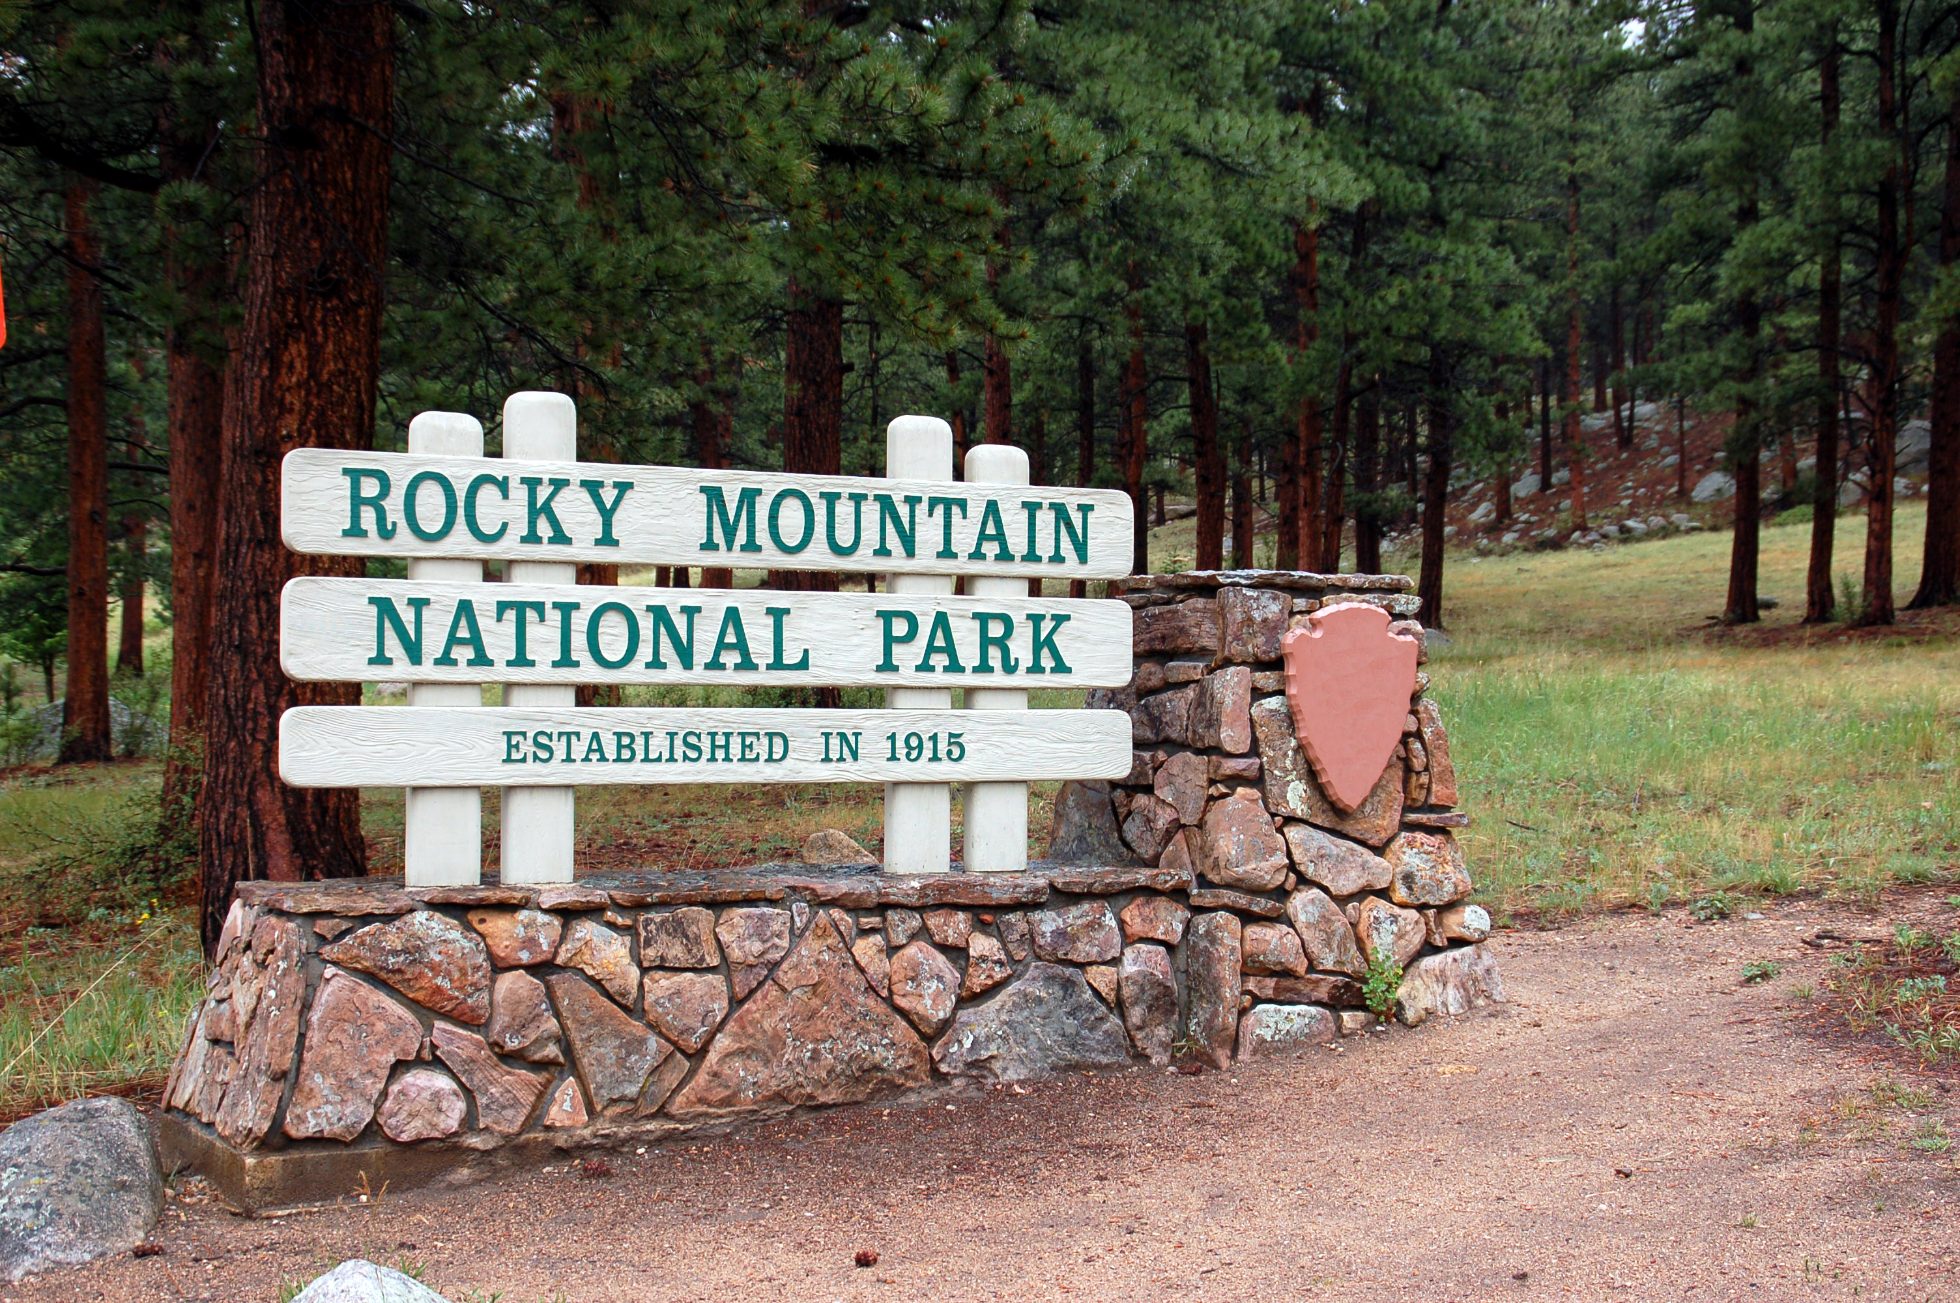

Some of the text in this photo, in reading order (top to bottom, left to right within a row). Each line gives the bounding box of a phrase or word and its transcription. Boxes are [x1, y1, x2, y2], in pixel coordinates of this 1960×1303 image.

[341, 467, 1095, 565] ROCKY MOUNTAIN
[367, 596, 1073, 675] NATIONAL PARK
[501, 730, 966, 764] ESTABLISHED IN 1915
